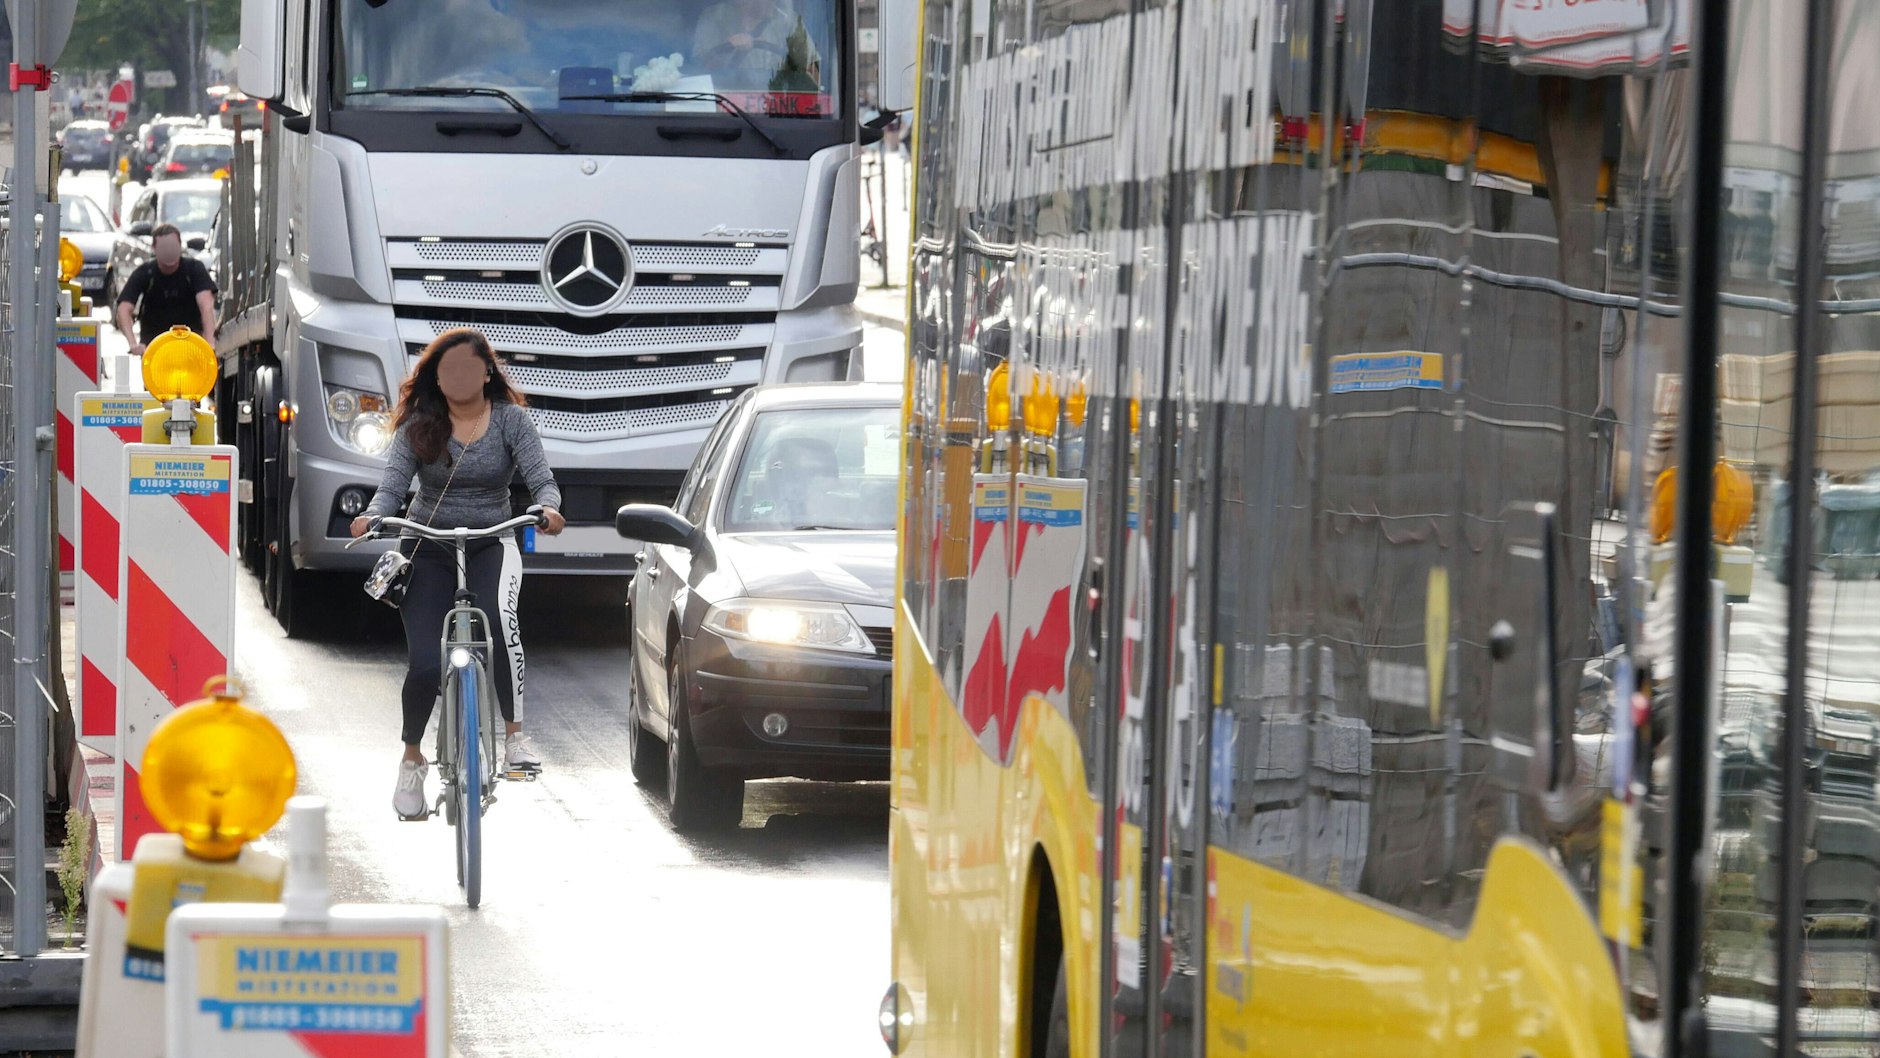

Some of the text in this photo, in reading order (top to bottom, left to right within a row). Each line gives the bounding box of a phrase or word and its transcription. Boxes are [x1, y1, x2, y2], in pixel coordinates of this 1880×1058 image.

[102, 402, 143, 410] NIEMEIER
[155, 462, 205, 471] NIEMEIER
[140, 479, 219, 489] 01805-308050
[503, 575, 525, 696] new balance
[237, 948, 398, 973] NIEMEIER
